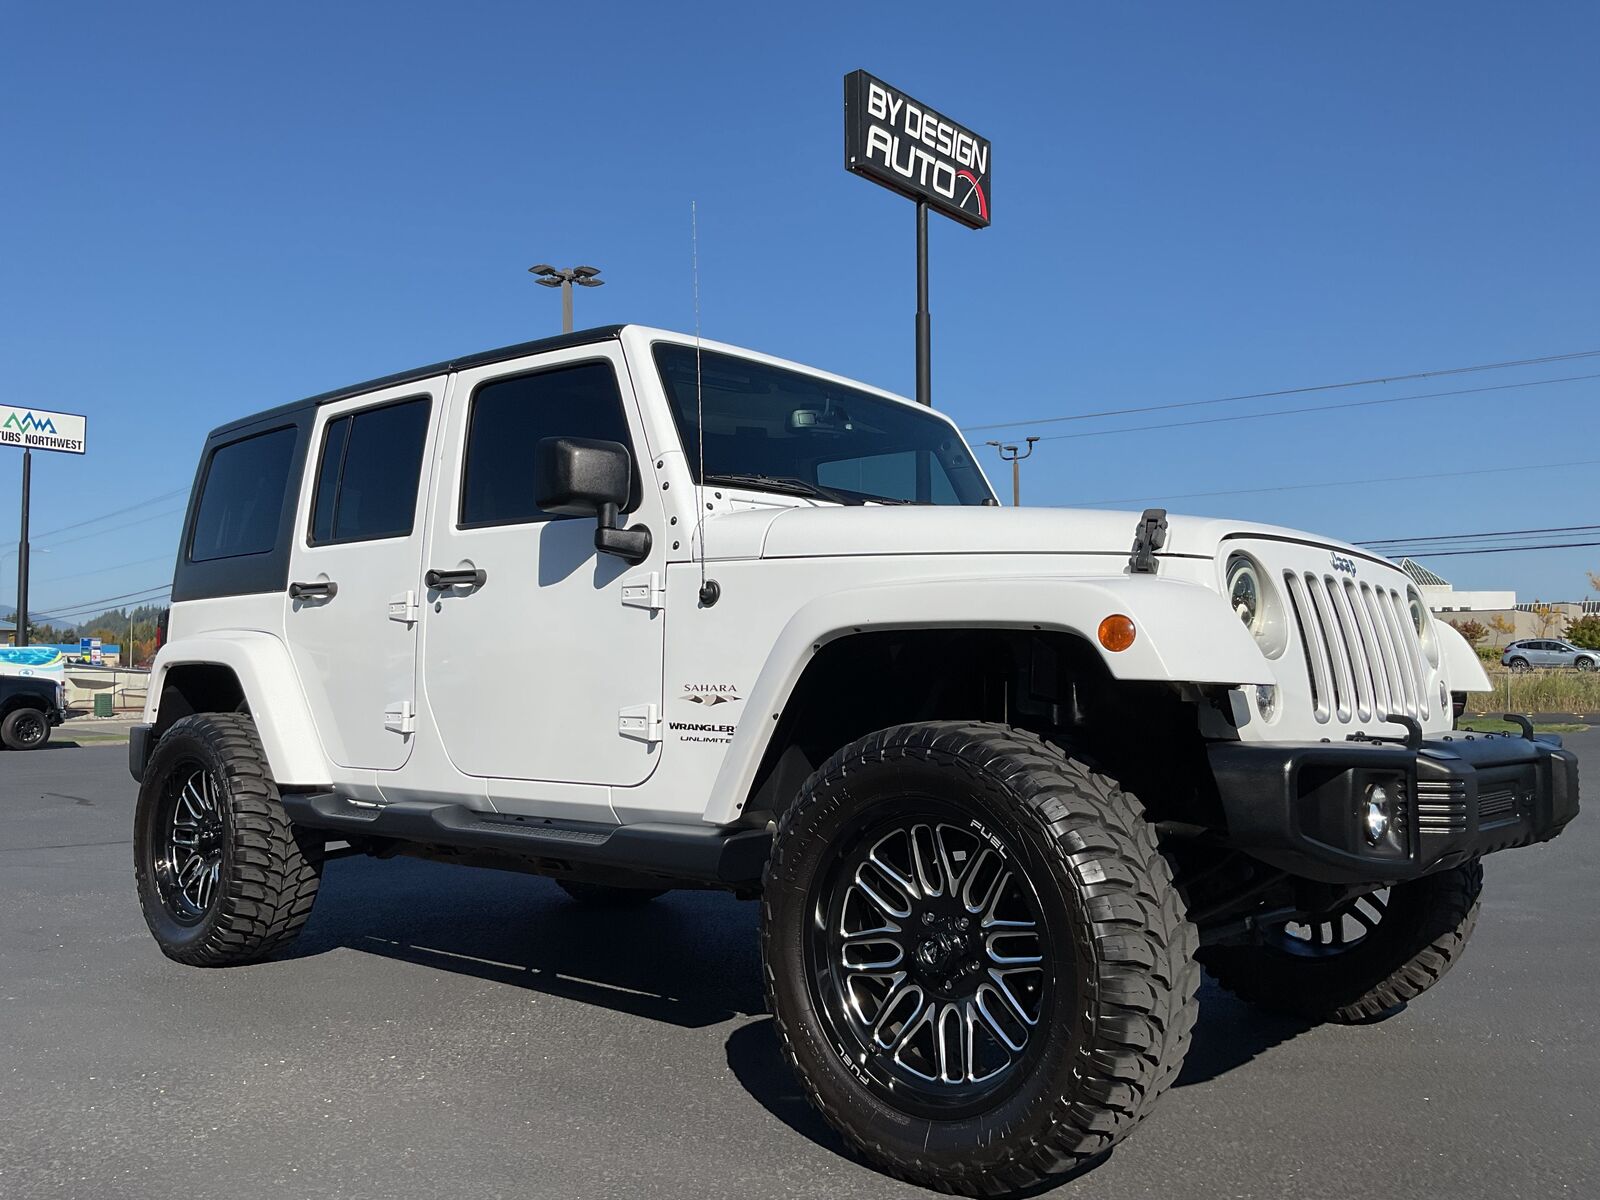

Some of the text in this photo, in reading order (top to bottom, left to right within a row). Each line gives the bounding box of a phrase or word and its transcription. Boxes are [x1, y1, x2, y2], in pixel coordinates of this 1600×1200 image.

[868, 83, 987, 174] BY DESIGN
[866, 124, 956, 199] AUTO
[25, 433, 82, 450] NORTHWEST
[1330, 551, 1357, 577] Jeep
[684, 684, 737, 692] SAHARA
[669, 722, 735, 733] WRANGLER
[680, 735, 732, 744] UNLIMITE
[970, 819, 1007, 859] FUEL
[837, 1042, 870, 1085] FUEL
